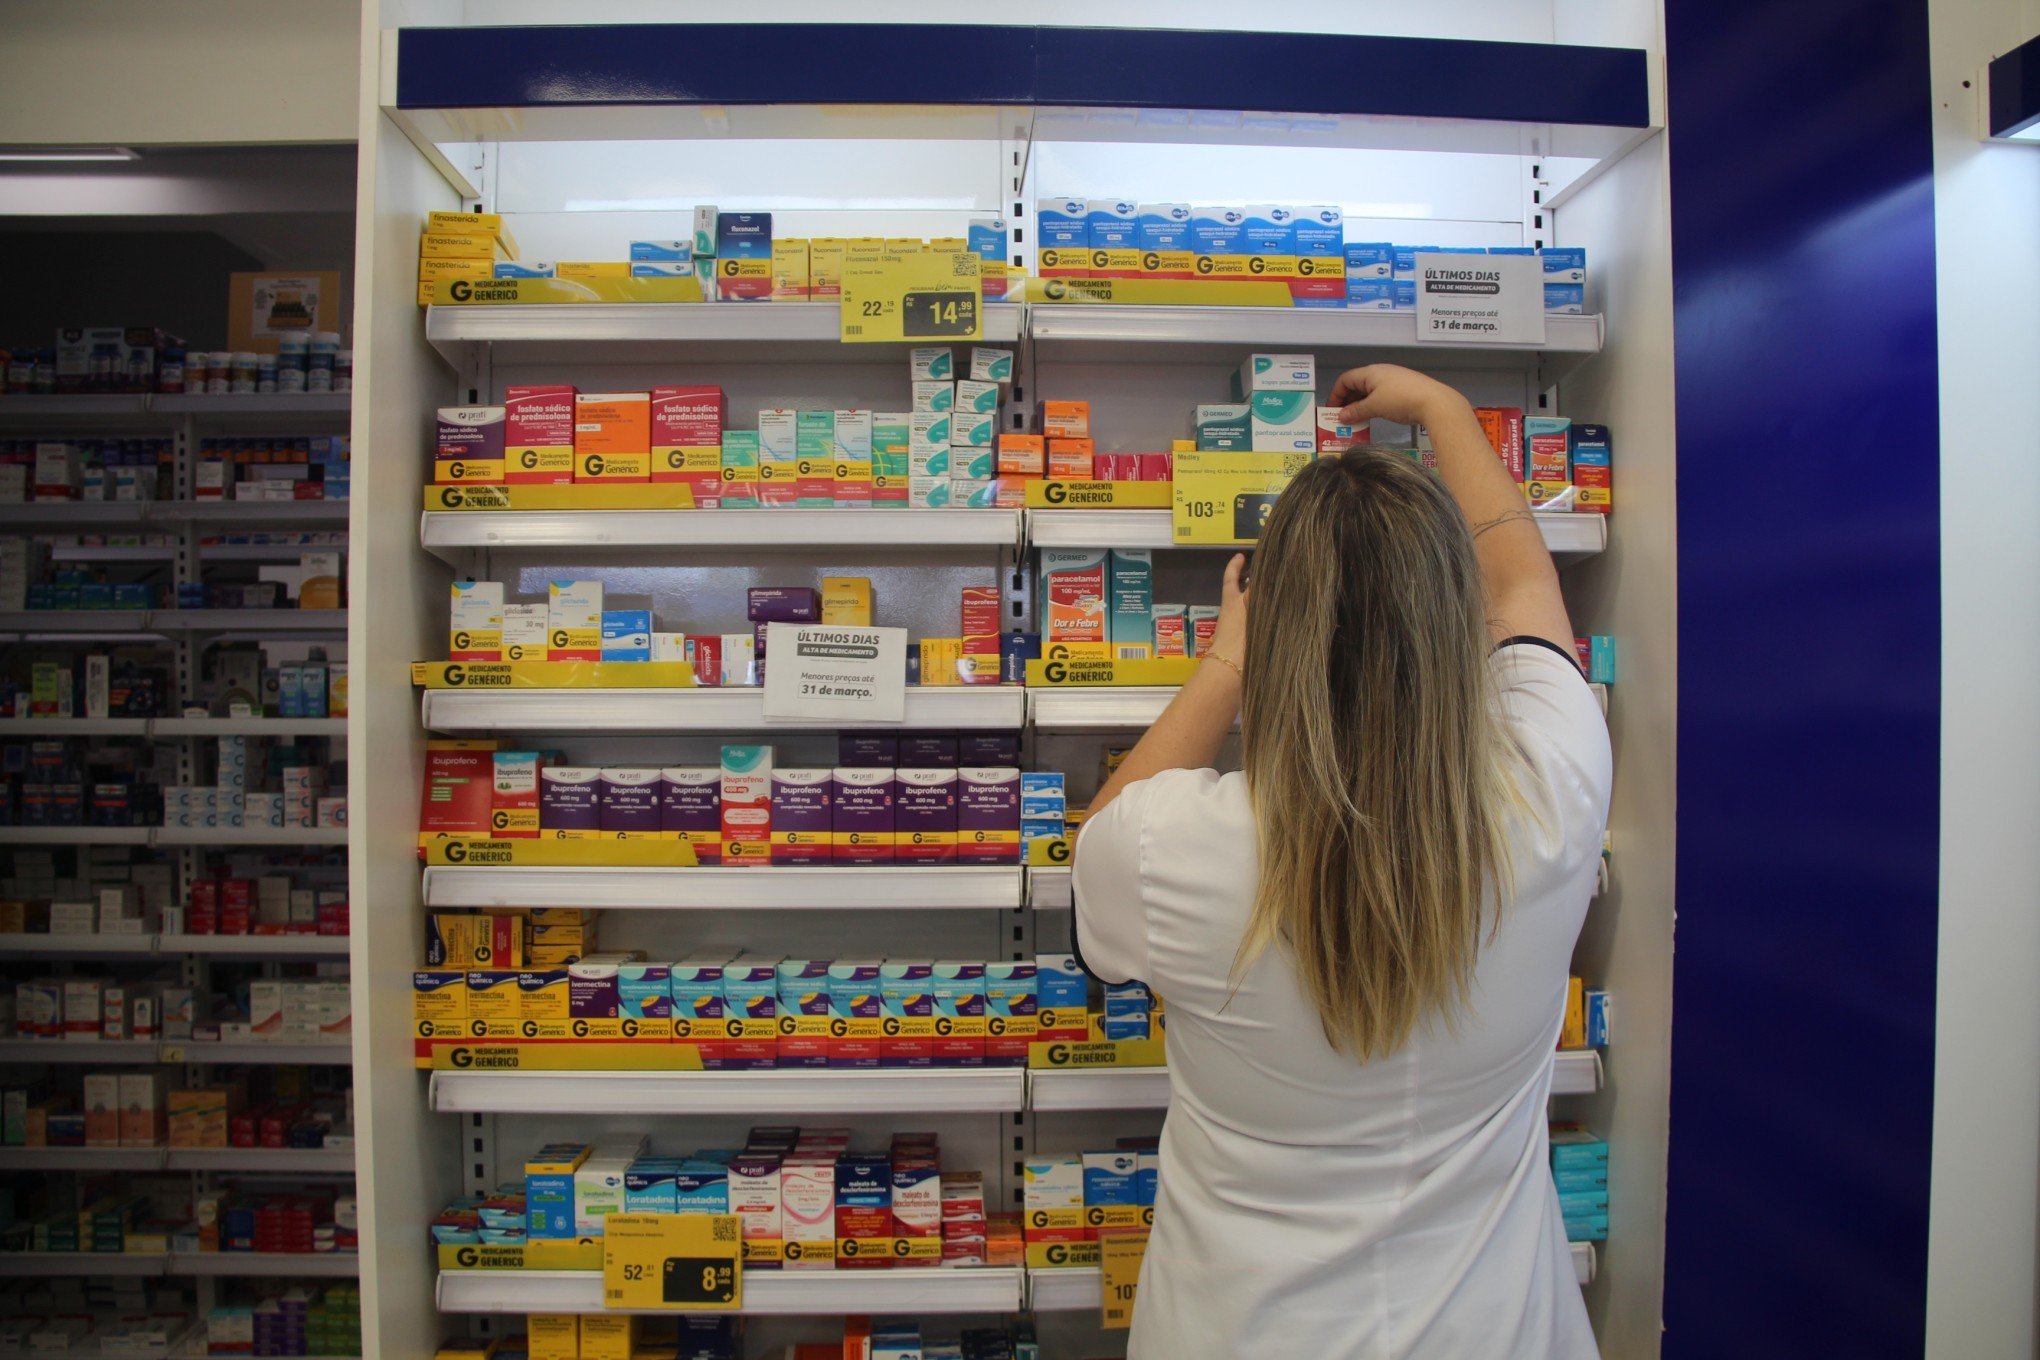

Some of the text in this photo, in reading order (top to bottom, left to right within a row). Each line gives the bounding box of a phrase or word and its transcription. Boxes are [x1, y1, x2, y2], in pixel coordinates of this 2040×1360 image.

[434, 214, 478, 223] finasterida
[428, 237, 471, 245] finasterida
[426, 261, 470, 269] finasterida
[1425, 268, 1500, 281] ÚLTIMOS DIAS
[451, 281, 472, 301] G
[475, 288, 517, 300] GENÉRICO
[1069, 288, 1111, 299] GENÉRICO
[863, 301, 881, 316] 22
[930, 302, 957, 324] 14
[1431, 308, 1498, 318] Menores preços até
[1433, 320, 1498, 333] 31 de março.
[518, 404, 571, 413] fosfato sódico
[664, 404, 718, 413] fosfato sódico
[468, 411, 486, 421] prati
[521, 412, 571, 422] prednisolona
[668, 413, 718, 422] prednisolona
[1510, 419, 1521, 472] paracetamol
[540, 458, 570, 466] Genérico
[585, 454, 604, 476] G
[687, 458, 717, 466] Genérico
[606, 464, 639, 474] Genérico
[441, 487, 464, 508] G
[1045, 483, 1066, 503] G
[1069, 490, 1112, 503] GENÉRICO
[466, 495, 508, 507] GENÉRICO
[1185, 502, 1213, 517] 103
[1051, 575, 1100, 583] paracetamol
[1054, 619, 1068, 627] Dor
[1076, 619, 1098, 628] Febre
[797, 630, 879, 645] ÚLTIMOS DIAS
[471, 639, 498, 648] Genérico
[444, 665, 466, 685] G
[801, 672, 833, 681] Menores
[834, 674, 860, 683] preços
[1045, 662, 1067, 683] G
[1069, 669, 1113, 682] GENÉRICO
[468, 674, 511, 685] GENÉRICO
[802, 685, 872, 699] 31 de março.
[433, 757, 477, 765] ibuprofeno
[497, 769, 532, 777] ibuprofeno
[724, 776, 763, 784] ibuprofeno
[551, 785, 590, 793] ibuprofeno
[781, 787, 822, 795] ibuprofeno
[843, 787, 884, 795] ibuprofeno
[906, 787, 947, 795] ibuprofeno
[968, 786, 1009, 794] ibuprofeno
[445, 842, 466, 862] G
[469, 850, 512, 862] GENÉRICO
[1047, 841, 1069, 861] G
[640, 1028, 668, 1036] Genérico
[692, 1028, 721, 1036] Genérico
[745, 1028, 773, 1036] Genérico
[849, 1027, 877, 1035] Genérico
[901, 1026, 930, 1034] Genérico
[954, 1025, 982, 1034] Genérico
[1007, 1025, 1036, 1034] Genérico
[451, 1047, 472, 1067] G
[1048, 1044, 1070, 1064] G
[1072, 1051, 1115, 1063] GENÉRICO
[475, 1055, 518, 1067] GENÉRICO
[749, 1166, 764, 1175] prati
[626, 1195, 674, 1204] Loratadina
[678, 1196, 726, 1204] Loratadina
[457, 1248, 478, 1267] G
[1046, 1244, 1067, 1264] G
[481, 1256, 523, 1267] GENÉRICO
[624, 1265, 642, 1280] 52
[703, 1267, 716, 1291] 8
